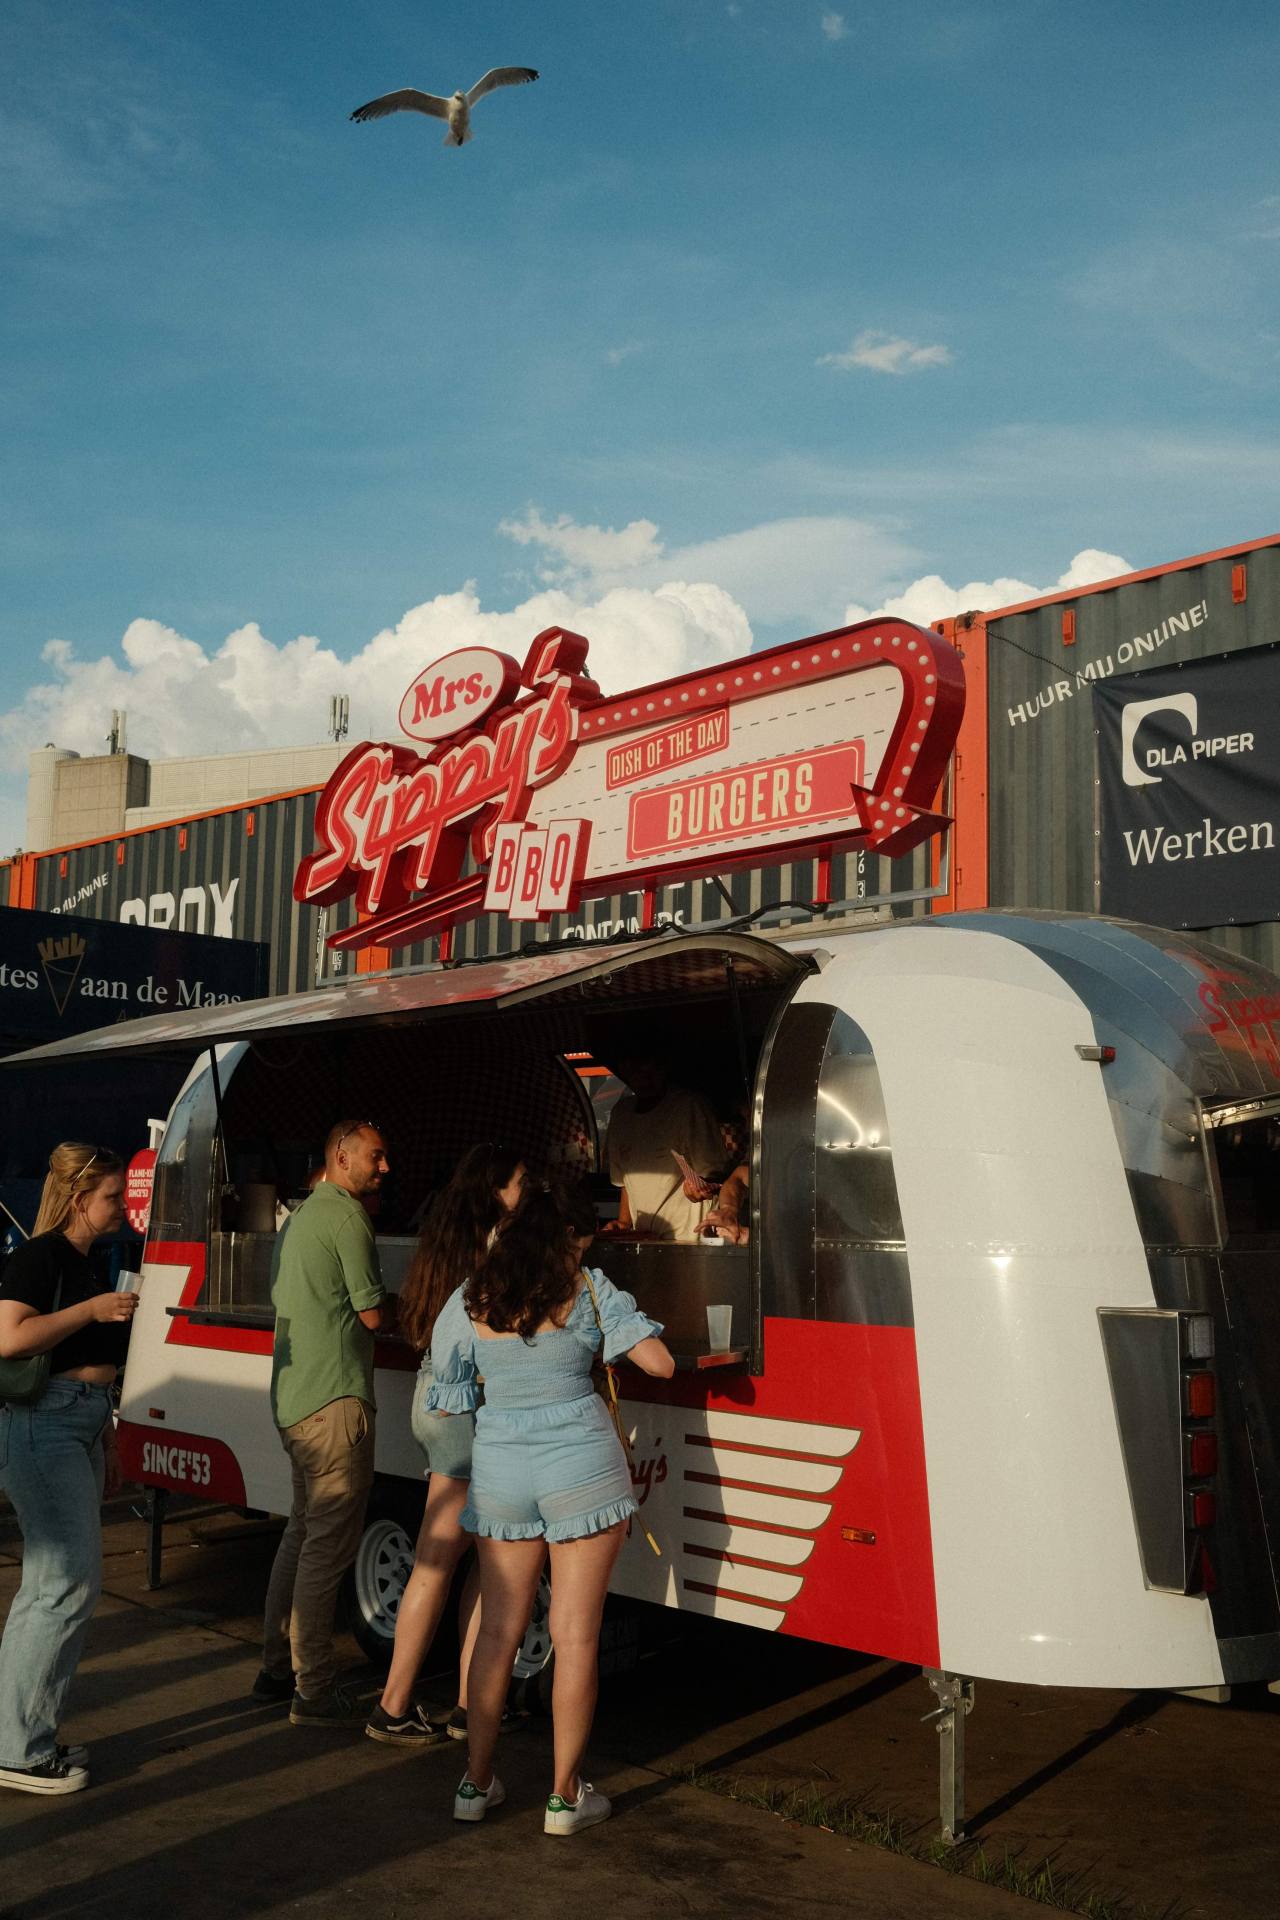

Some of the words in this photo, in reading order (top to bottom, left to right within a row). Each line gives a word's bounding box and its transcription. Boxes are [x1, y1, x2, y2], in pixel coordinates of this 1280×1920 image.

[1007, 679, 1074, 727] HUUR
[1116, 600, 1209, 665] ONLINE!
[411, 671, 493, 726] Mrs.
[305, 636, 572, 912] Sippy's
[611, 749, 643, 782] DISH
[646, 740, 664, 768] OF
[668, 728, 693, 760] THE
[697, 714, 724, 749] DAY
[1146, 744, 1187, 769] DLA
[1192, 731, 1255, 761] PIPER
[666, 762, 814, 842] BURGERS
[495, 832, 571, 903] BBQ
[1122, 818, 1276, 867] Werken
[79, 976, 129, 1000] aan
[136, 975, 169, 1005] de
